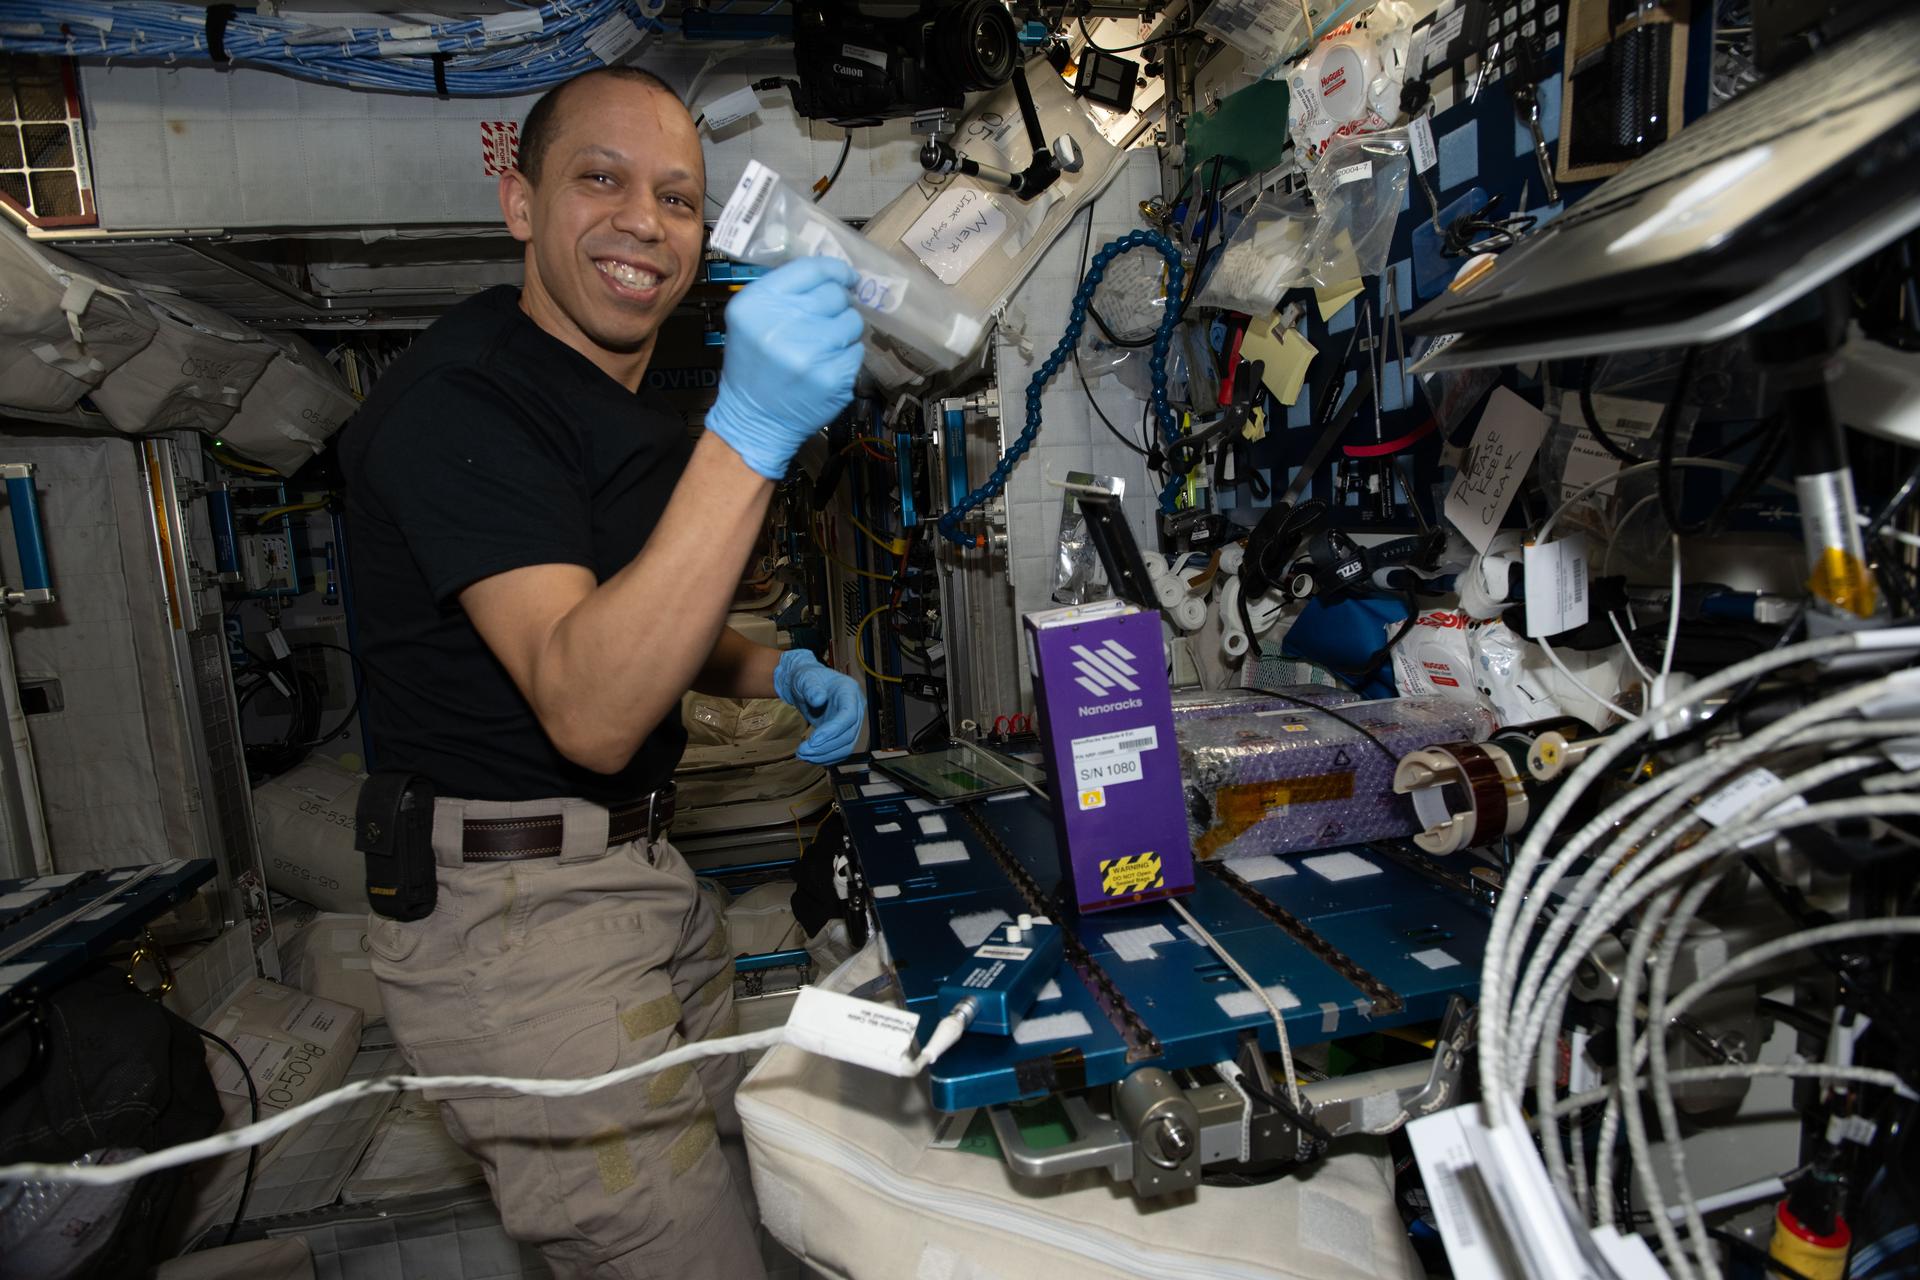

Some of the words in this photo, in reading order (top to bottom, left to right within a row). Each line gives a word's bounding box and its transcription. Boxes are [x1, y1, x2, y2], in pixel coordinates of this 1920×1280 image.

[833, 63, 863, 78] Canon
[73, 121, 81, 146] Exhaust
[948, 210, 988, 254] MEIR
[1453, 430, 1501, 506] PLEASE
[1475, 444, 1504, 495] KEEP
[1482, 451, 1521, 526] CLEAR
[1078, 698, 1143, 718] Nanoracks
[1081, 767, 1103, 781] S/N
[1107, 760, 1136, 776] 1080
[1113, 862, 1150, 874] WARNING
[1123, 872, 1135, 880] NOT
